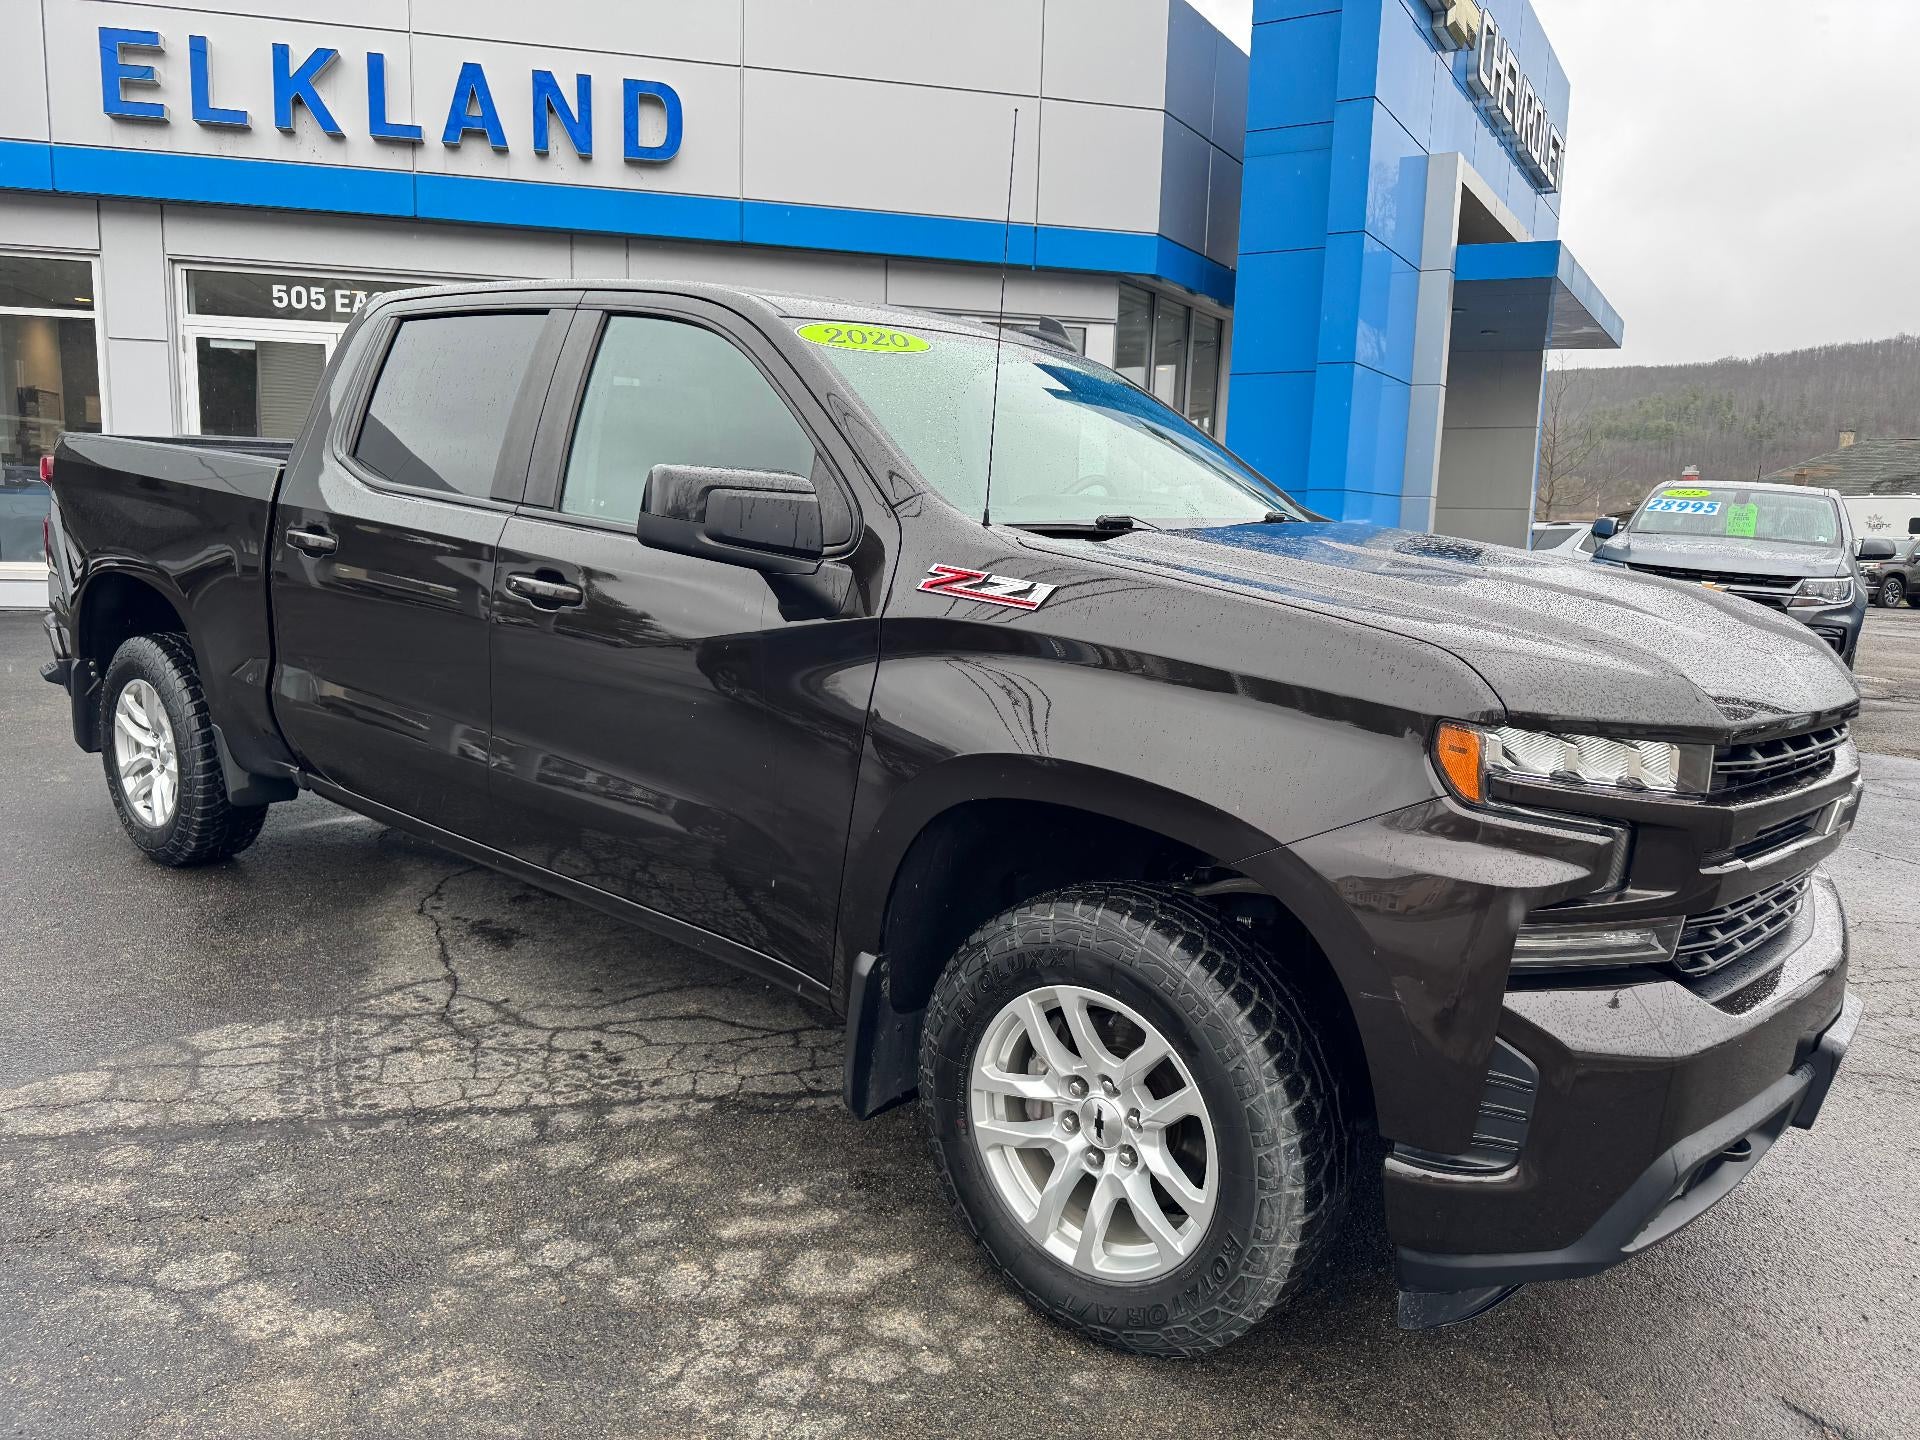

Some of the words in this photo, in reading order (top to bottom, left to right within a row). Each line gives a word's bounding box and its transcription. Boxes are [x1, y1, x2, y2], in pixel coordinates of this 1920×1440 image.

[97, 26, 684, 164] ELKLAND
[1470, 8, 1566, 191] CHEVROLET
[272, 284, 327, 311] 505
[334, 289, 385, 313] EA
[823, 327, 910, 348] 2020
[1646, 499, 1720, 514] 28995
[915, 562, 1060, 612] Z71
[1127, 1230, 1245, 1328] ROTATOR
[1056, 1294, 1119, 1325] A/T
